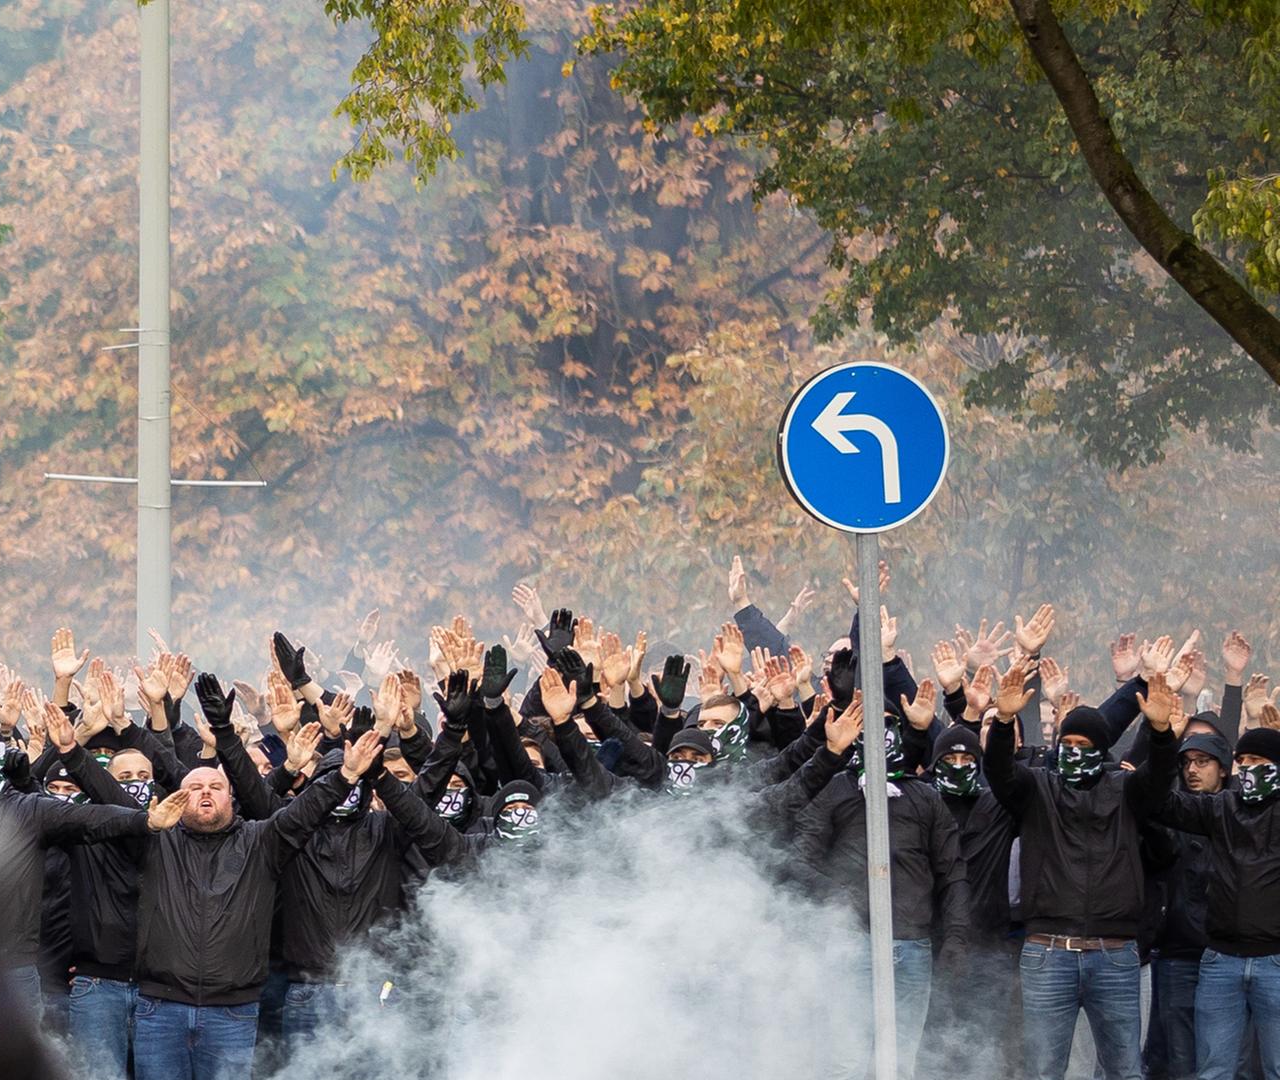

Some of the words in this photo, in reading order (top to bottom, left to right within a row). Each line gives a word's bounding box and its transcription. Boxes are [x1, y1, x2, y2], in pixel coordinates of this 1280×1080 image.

[672, 763, 694, 784] 96
[441, 791, 462, 814] 96
[514, 808, 536, 827] 96
